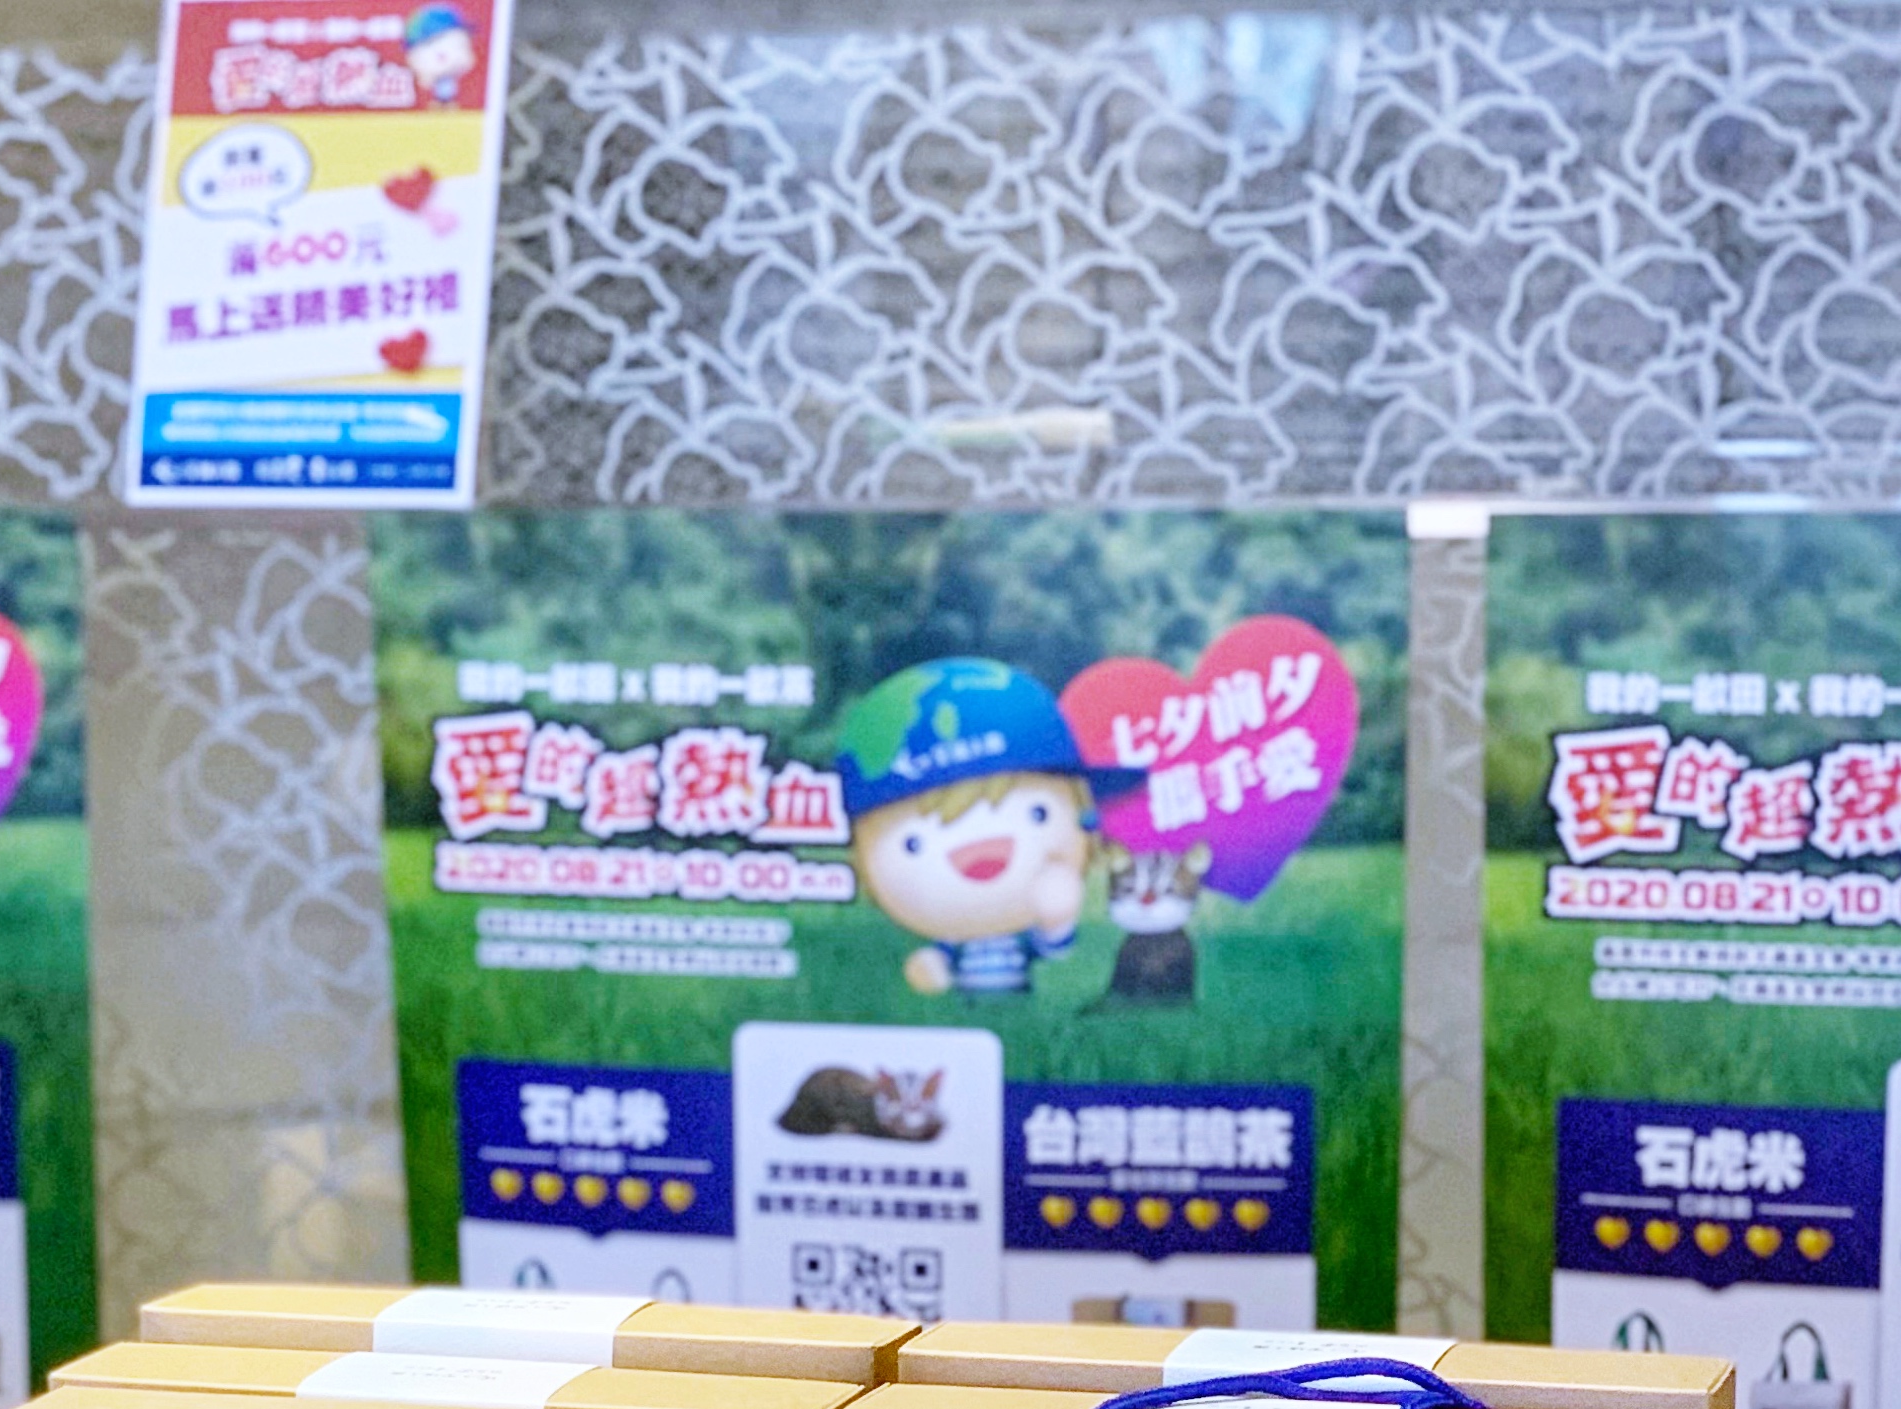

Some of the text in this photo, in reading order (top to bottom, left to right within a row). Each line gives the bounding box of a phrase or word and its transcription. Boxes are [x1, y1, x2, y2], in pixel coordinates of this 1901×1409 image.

[1112, 652, 1322, 768] 七夕前夕
[433, 710, 851, 842] 愛的超熱血
[519, 1084, 670, 1149] 石虎米
[1635, 1125, 1806, 1194] 石虎米
